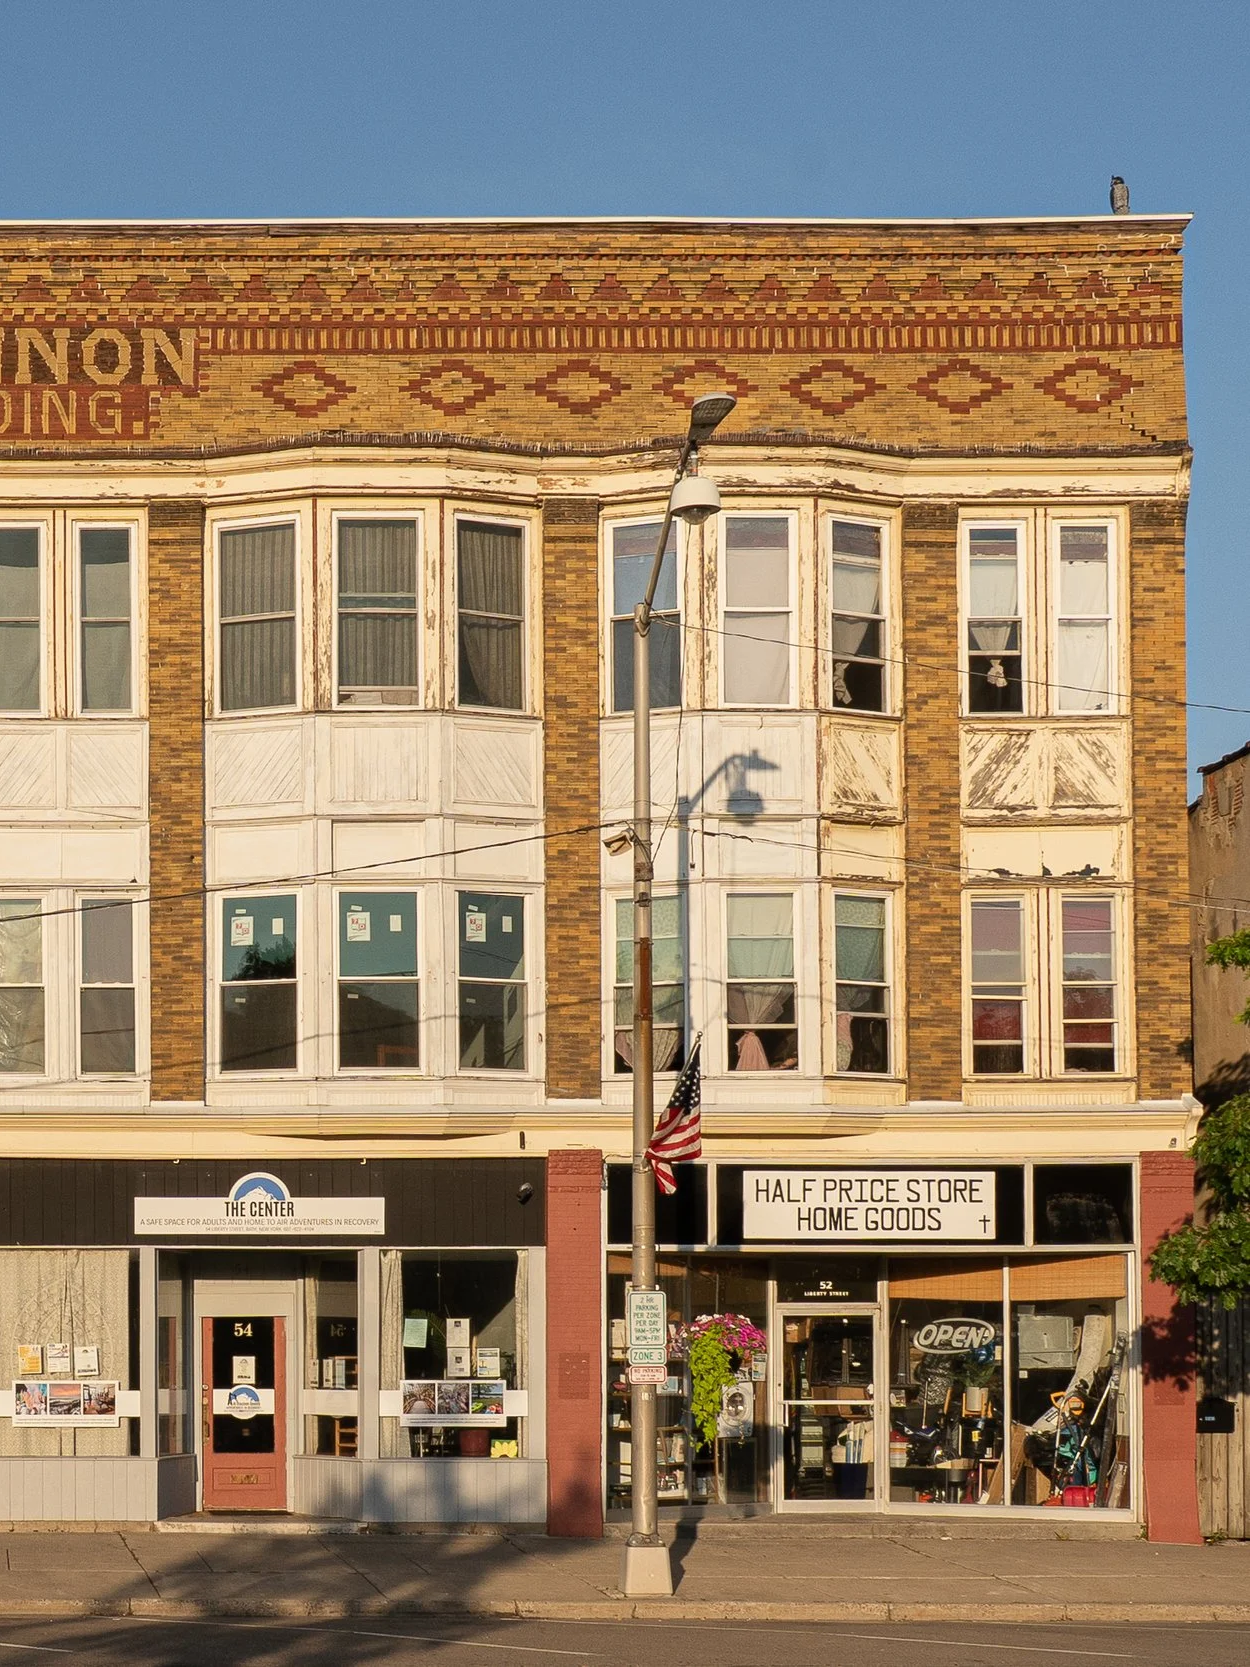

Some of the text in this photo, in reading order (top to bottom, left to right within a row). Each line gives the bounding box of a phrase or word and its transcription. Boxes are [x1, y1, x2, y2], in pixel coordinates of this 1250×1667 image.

[755, 1179, 983, 1203] HALF PRICE STORE
[224, 1201, 295, 1217] THE CENTER
[140, 1218, 379, 1226] A SAFE SPACE FOR ADULTS AND HOME TO AIR ADVENTURES IN RECOVERY
[798, 1207, 941, 1231] HOME GOODS
[819, 1280, 833, 1290] 52
[234, 1323, 253, 1337] 54
[918, 1324, 986, 1348] OPEN
[634, 1352, 663, 1361] ZONE 3
